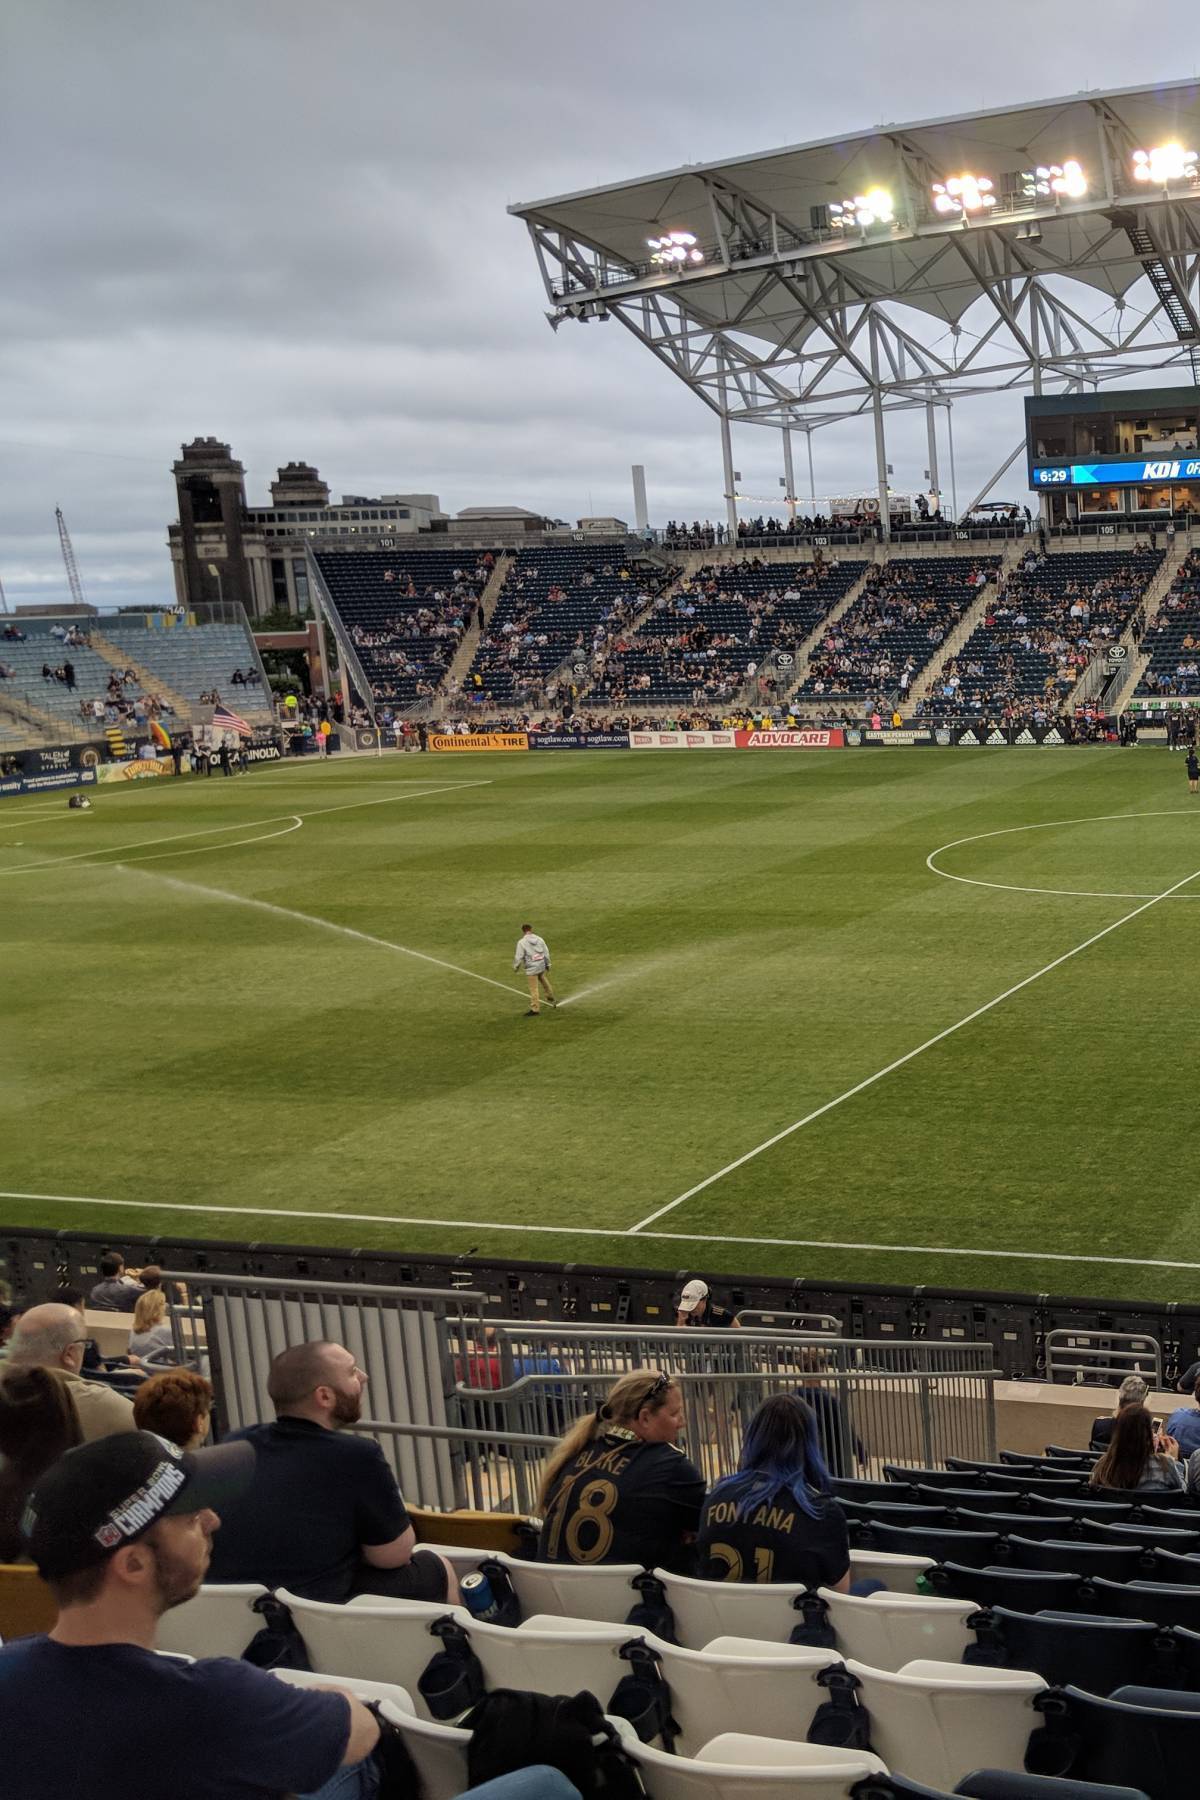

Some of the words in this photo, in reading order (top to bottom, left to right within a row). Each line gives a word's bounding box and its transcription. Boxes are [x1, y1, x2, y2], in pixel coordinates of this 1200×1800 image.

[1039, 470, 1066, 482] 6:29
[955, 531, 969, 540] 104
[1101, 526, 1114, 535] 105
[380, 539, 394, 547] 101
[814, 537, 827, 545] 103
[432, 736, 490, 749] Continental
[503, 738, 525, 746] TIRE
[749, 731, 830, 746] ADVOCARE
[41, 751, 63, 760] TALEN
[110, 1487, 147, 1520] SUPER
[113, 1462, 185, 1536] CHAMPIONS
[547, 1475, 618, 1565] 18
